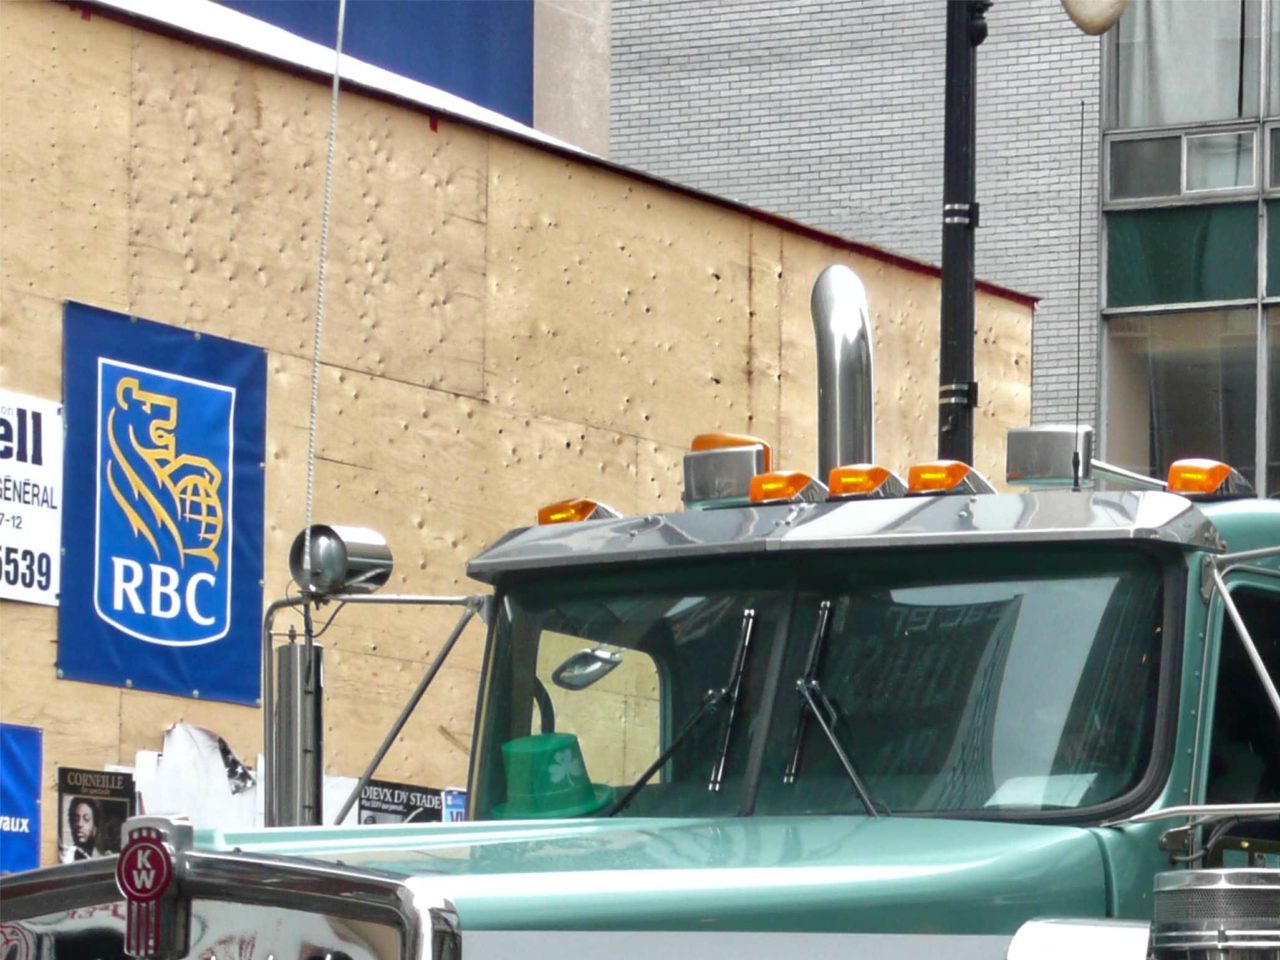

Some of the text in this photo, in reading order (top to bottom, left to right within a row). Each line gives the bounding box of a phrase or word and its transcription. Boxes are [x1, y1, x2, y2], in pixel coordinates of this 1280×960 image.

[0, 475, 58, 510] ÉNÉRAL
[0, 546, 52, 591] 539
[111, 556, 217, 626] RBC
[67, 771, 124, 790] CORNEILLE
[410, 793, 441, 809] STADE
